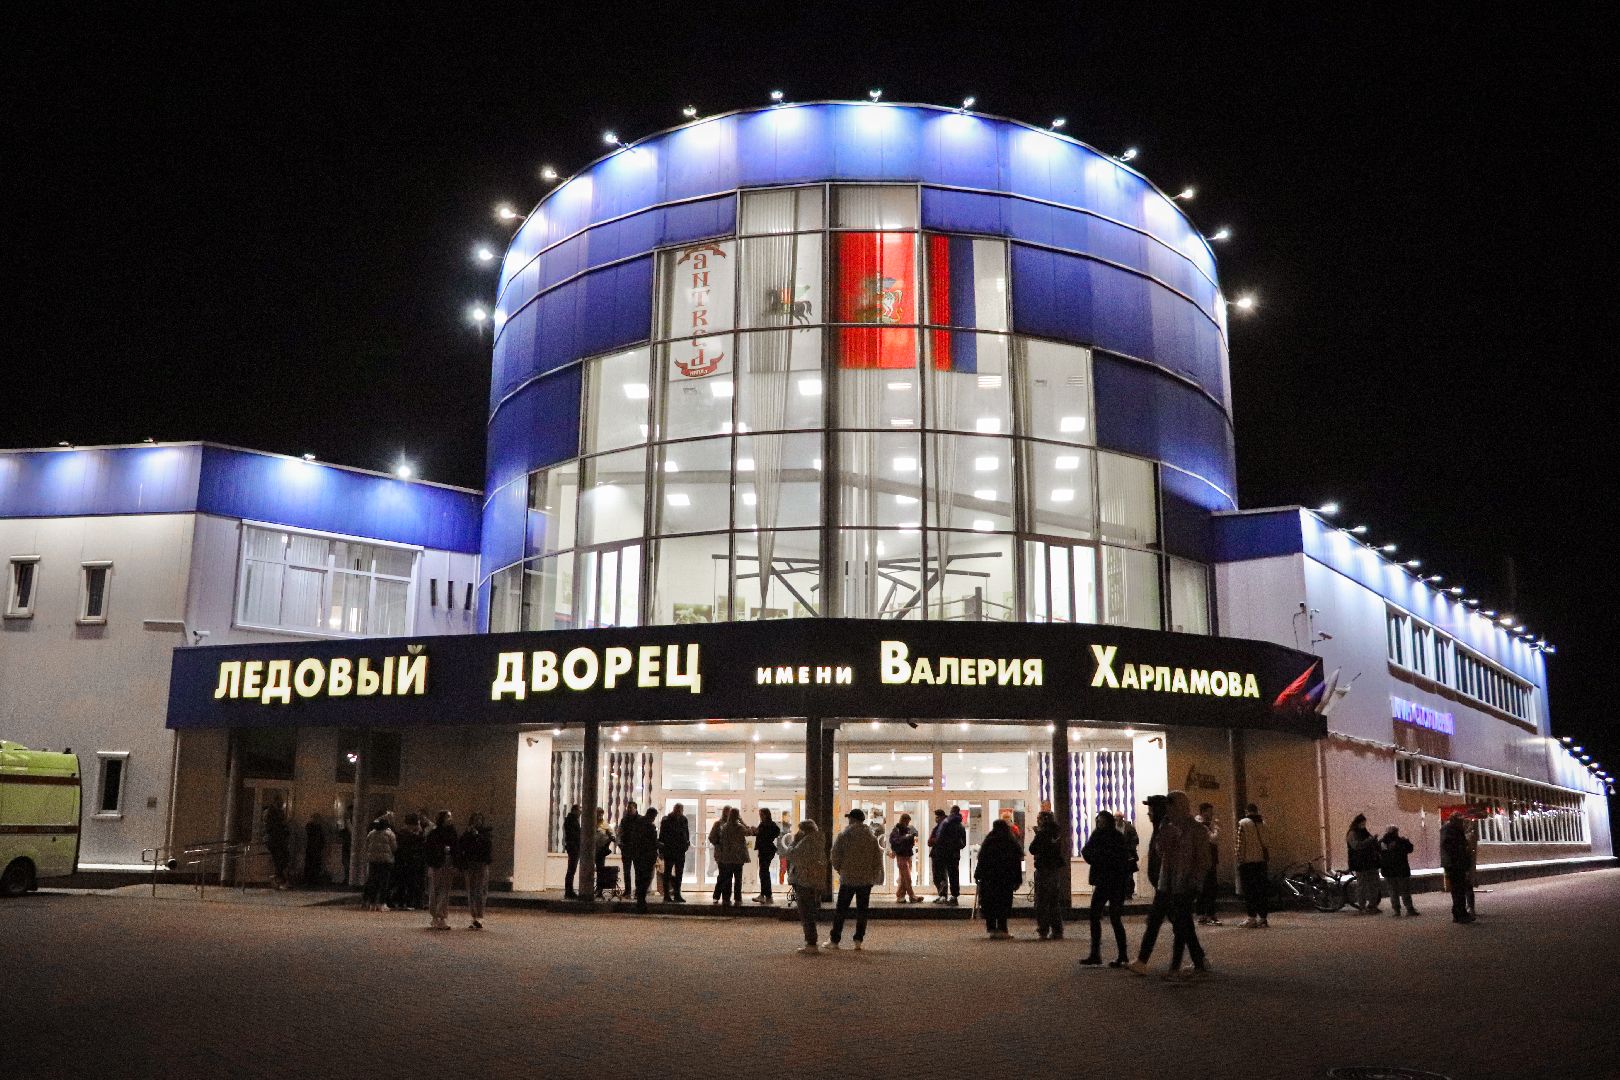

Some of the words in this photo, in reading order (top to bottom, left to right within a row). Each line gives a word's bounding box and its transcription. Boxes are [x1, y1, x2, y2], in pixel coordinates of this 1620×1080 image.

[214, 644, 427, 704] ЛЕДОВЫЙ
[492, 644, 701, 700] ДВОРЕЦ
[757, 667, 852, 684] ИМЕНИ
[881, 641, 1042, 685] ВАЛЕРИЯ
[1091, 643, 1261, 699] ХАРЛАМОВА
